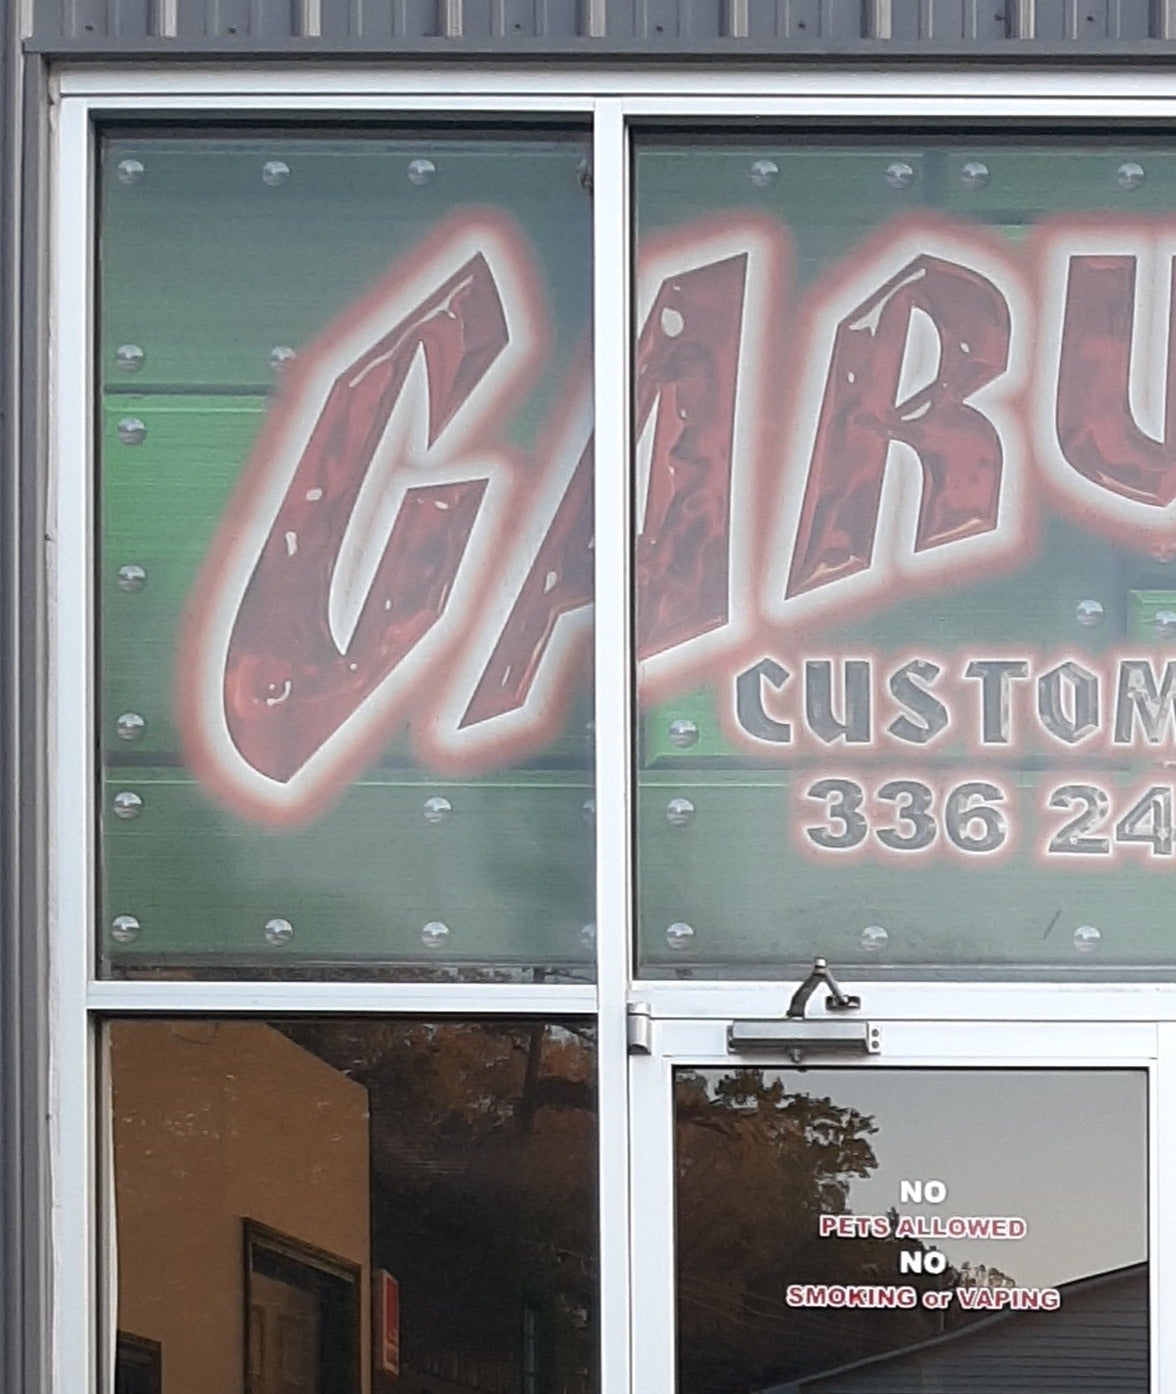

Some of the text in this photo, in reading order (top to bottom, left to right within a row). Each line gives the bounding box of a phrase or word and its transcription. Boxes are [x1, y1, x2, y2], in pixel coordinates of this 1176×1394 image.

[804, 776, 1008, 853] 336
[900, 1180, 947, 1203] NO
[819, 1214, 1027, 1239] PETS ALLOWED
[900, 1251, 947, 1275] NO
[787, 1285, 1060, 1311] SMOKING or VAPING
